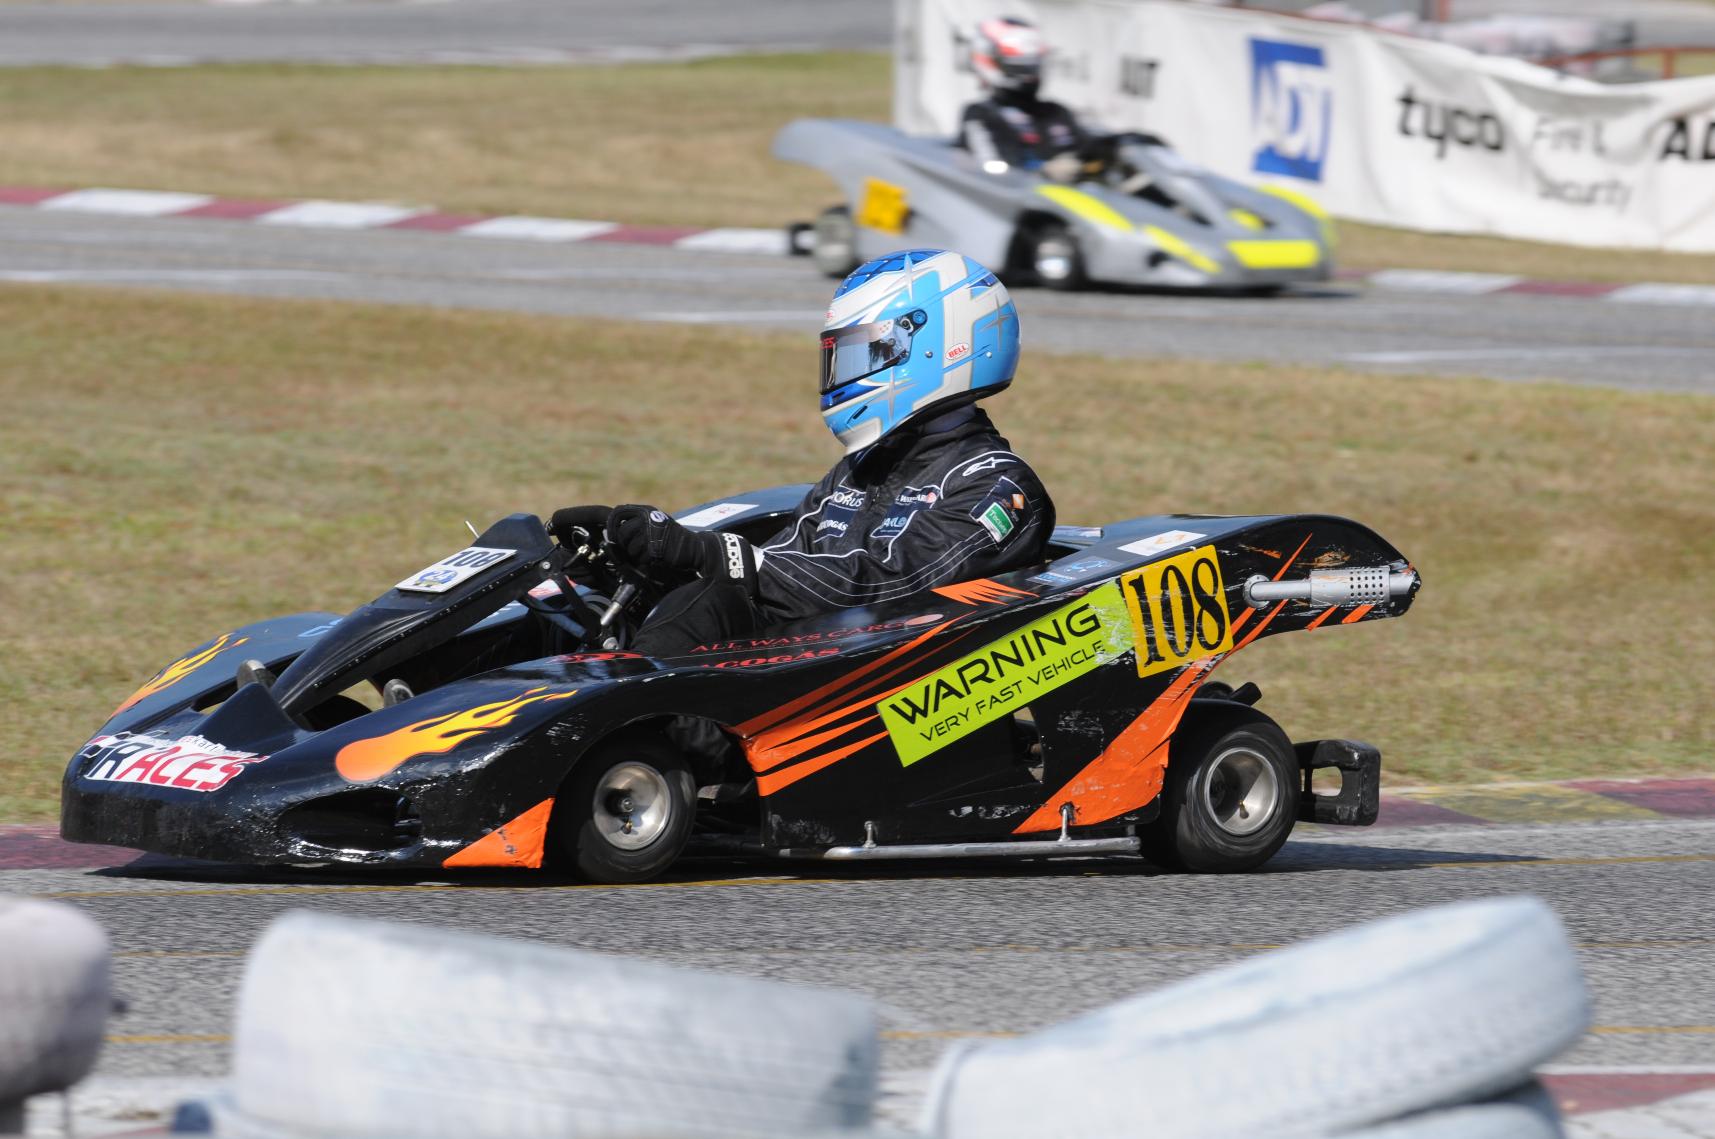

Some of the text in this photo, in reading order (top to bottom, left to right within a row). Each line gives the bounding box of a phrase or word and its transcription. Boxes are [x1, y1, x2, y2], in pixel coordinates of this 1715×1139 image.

[1396, 84, 1504, 160] tyco
[947, 345, 968, 358] BELL
[441, 550, 506, 568] 108
[721, 532, 745, 579] sparco
[750, 633, 821, 649] WAYS
[1128, 557, 1226, 668] 108
[889, 603, 1101, 725] WARNING
[919, 640, 1106, 742] VERY FAST VEHICLE
